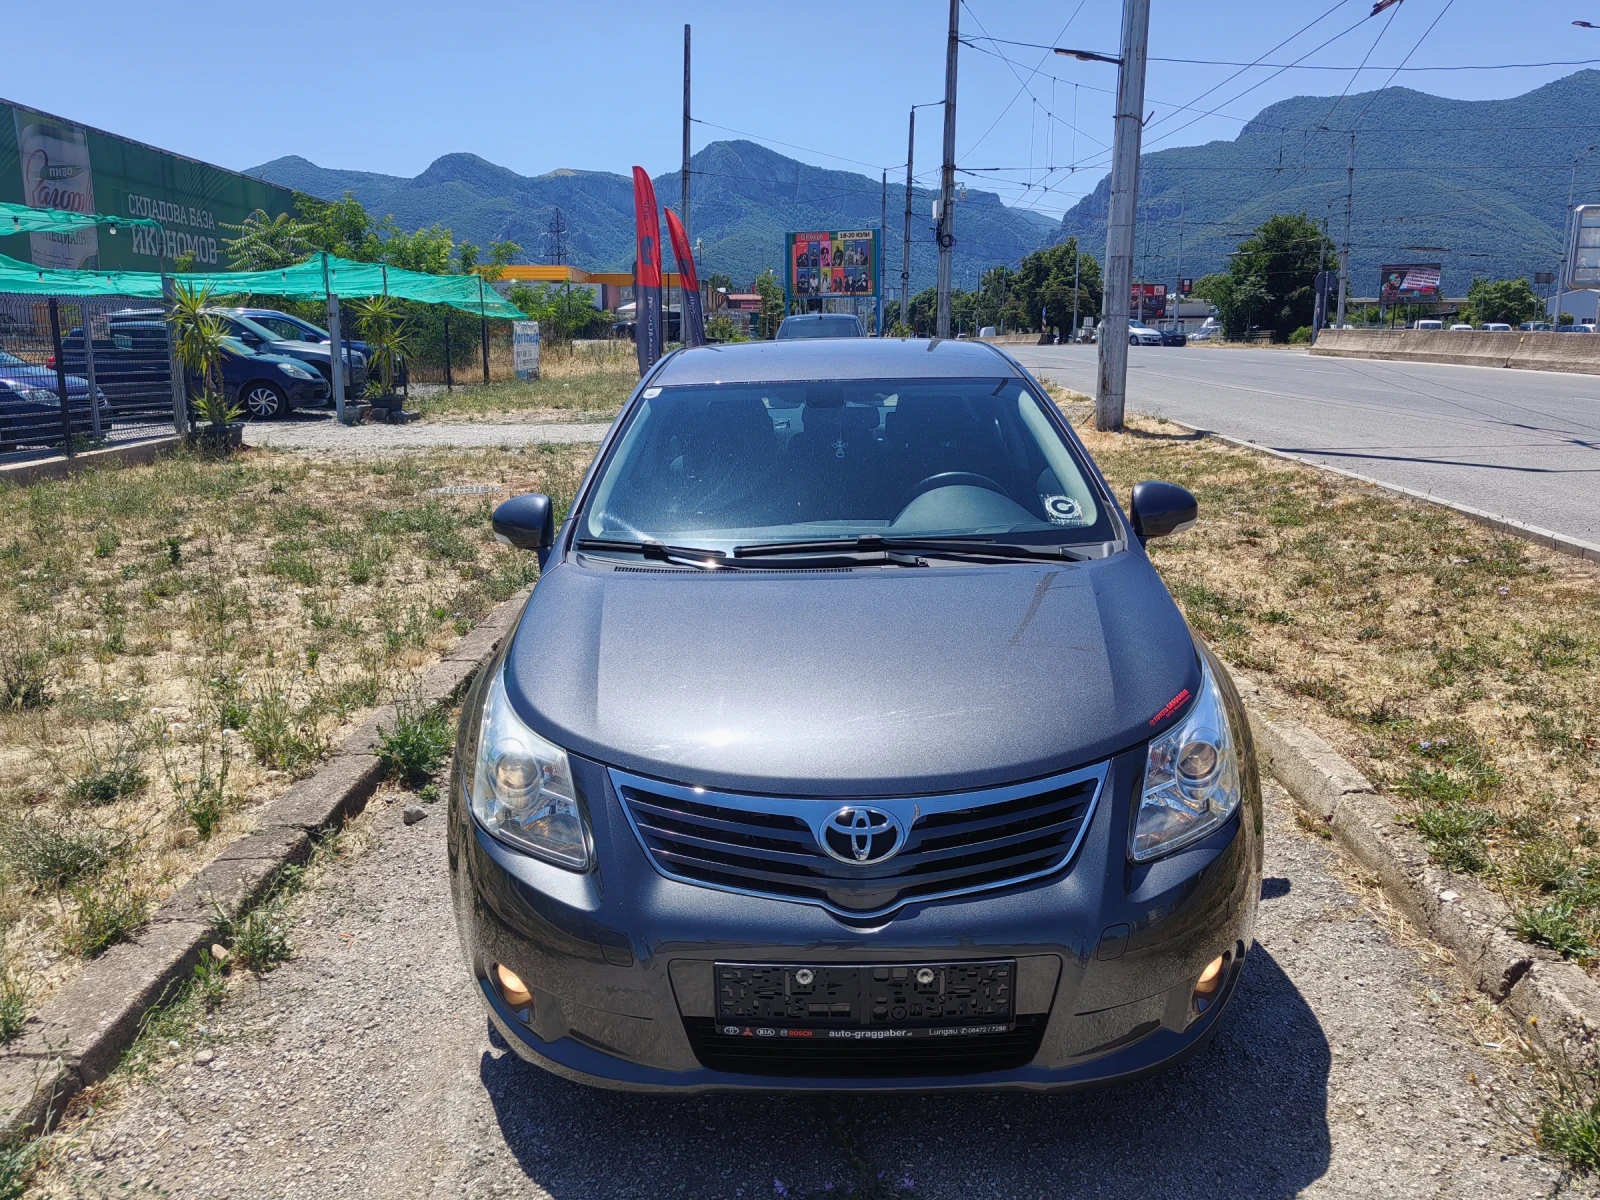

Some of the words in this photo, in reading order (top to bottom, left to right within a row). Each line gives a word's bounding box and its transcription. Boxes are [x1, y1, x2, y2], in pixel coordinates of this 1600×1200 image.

[49, 167, 73, 177] ПИВО
[128, 193, 188, 224] СКЛАДОВА
[189, 207, 216, 230] БАЗА
[132, 226, 218, 264] ИКОНОМОВ
[928, 1028, 958, 1036] Lungau
